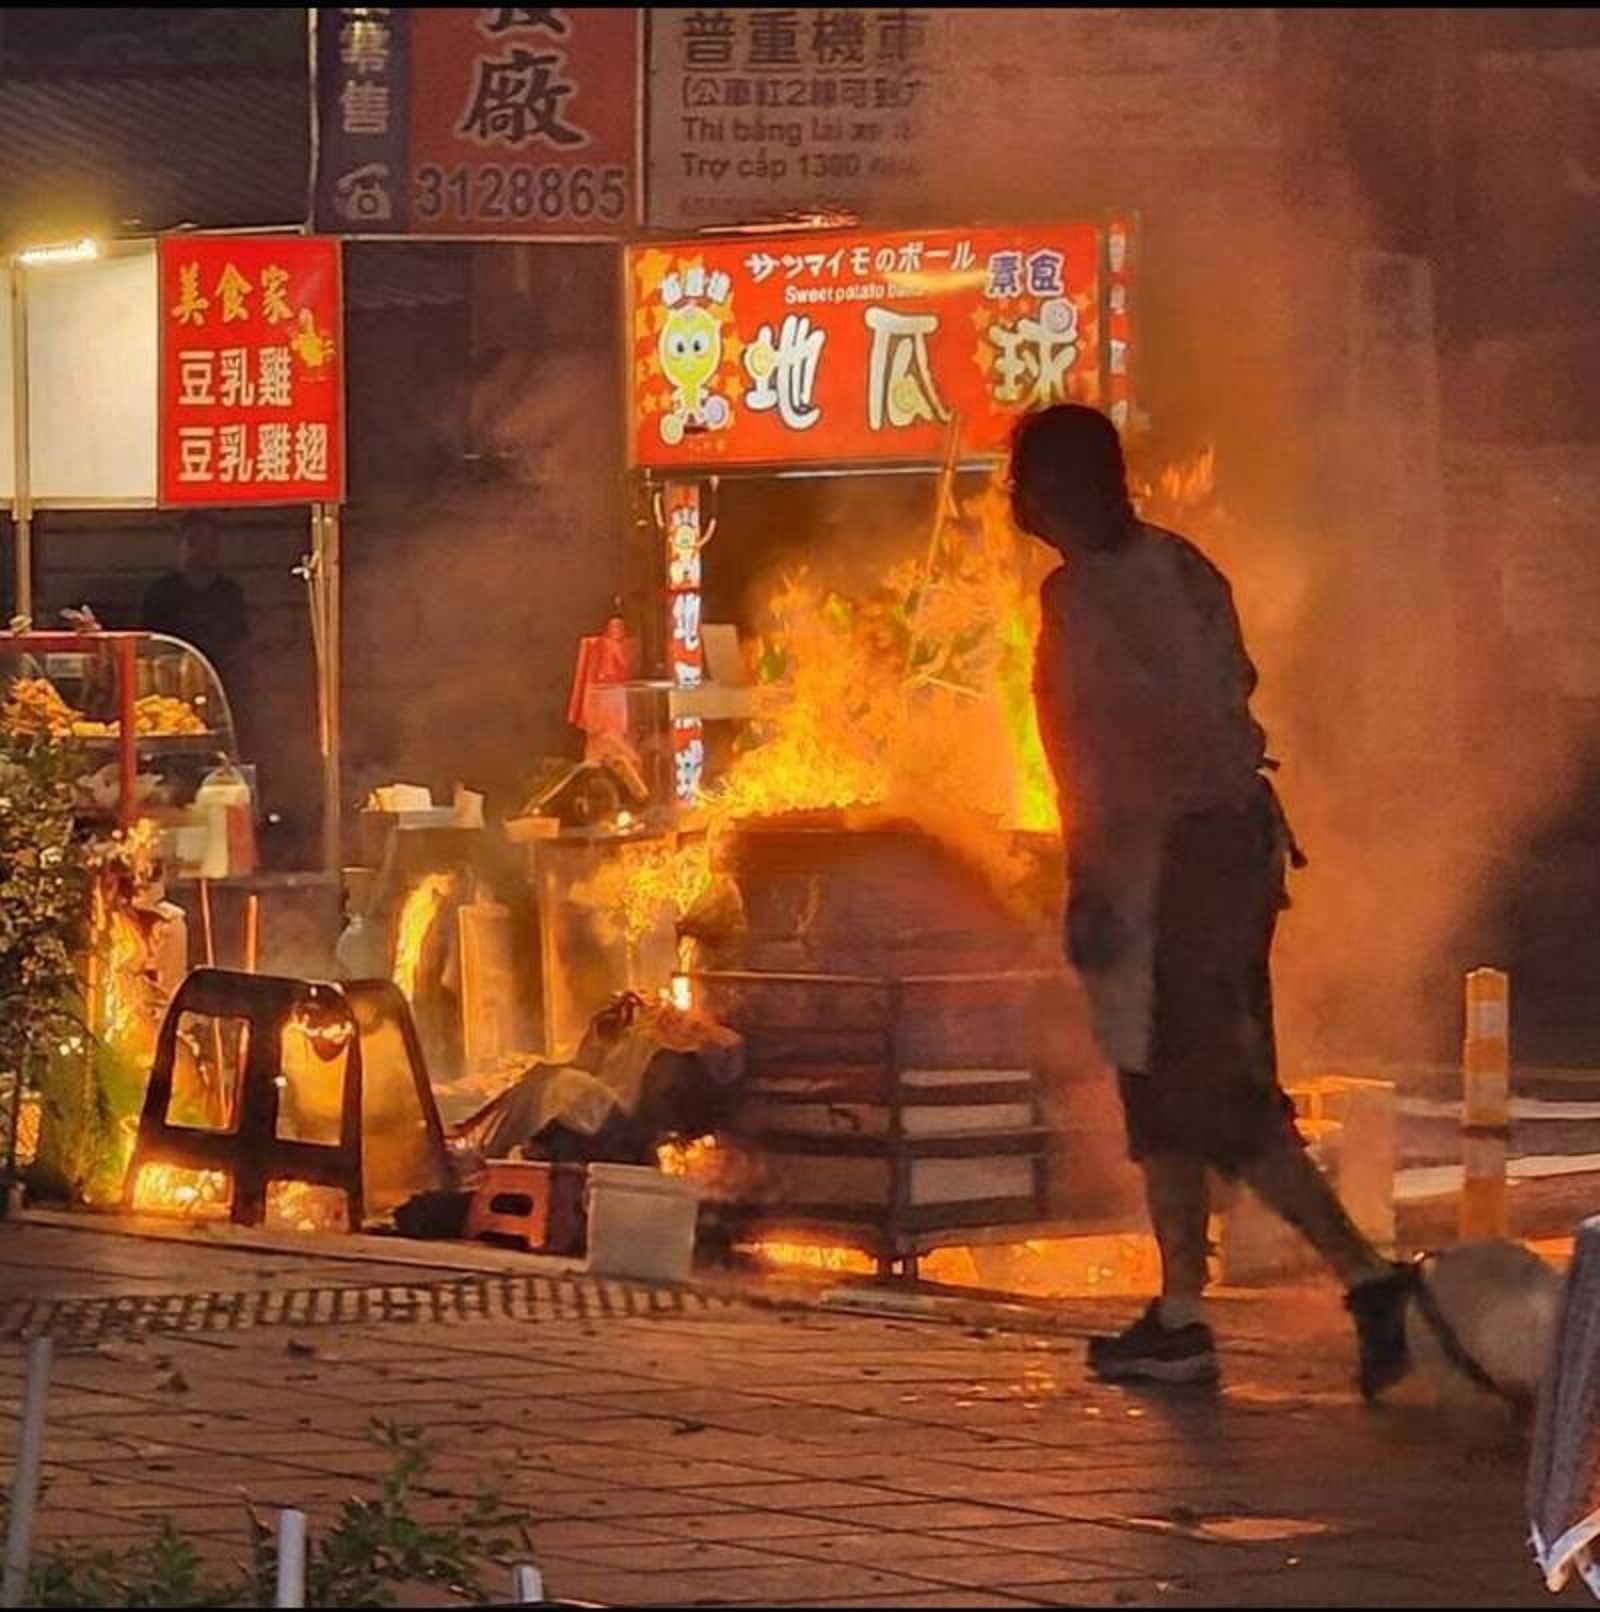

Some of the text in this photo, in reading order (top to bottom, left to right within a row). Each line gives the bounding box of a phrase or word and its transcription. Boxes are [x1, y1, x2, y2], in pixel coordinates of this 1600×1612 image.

[339, 8, 391, 135] 零售
[681, 116, 724, 142] Thi
[416, 164, 628, 220] 3128865
[171, 262, 295, 326] 美食家
[785, 285, 830, 305] Sweet
[985, 250, 1064, 298] 素食
[178, 347, 293, 407] 豆乳雞
[744, 302, 1078, 431] 地瓜球
[177, 422, 328, 483] 豆乳雞翅
